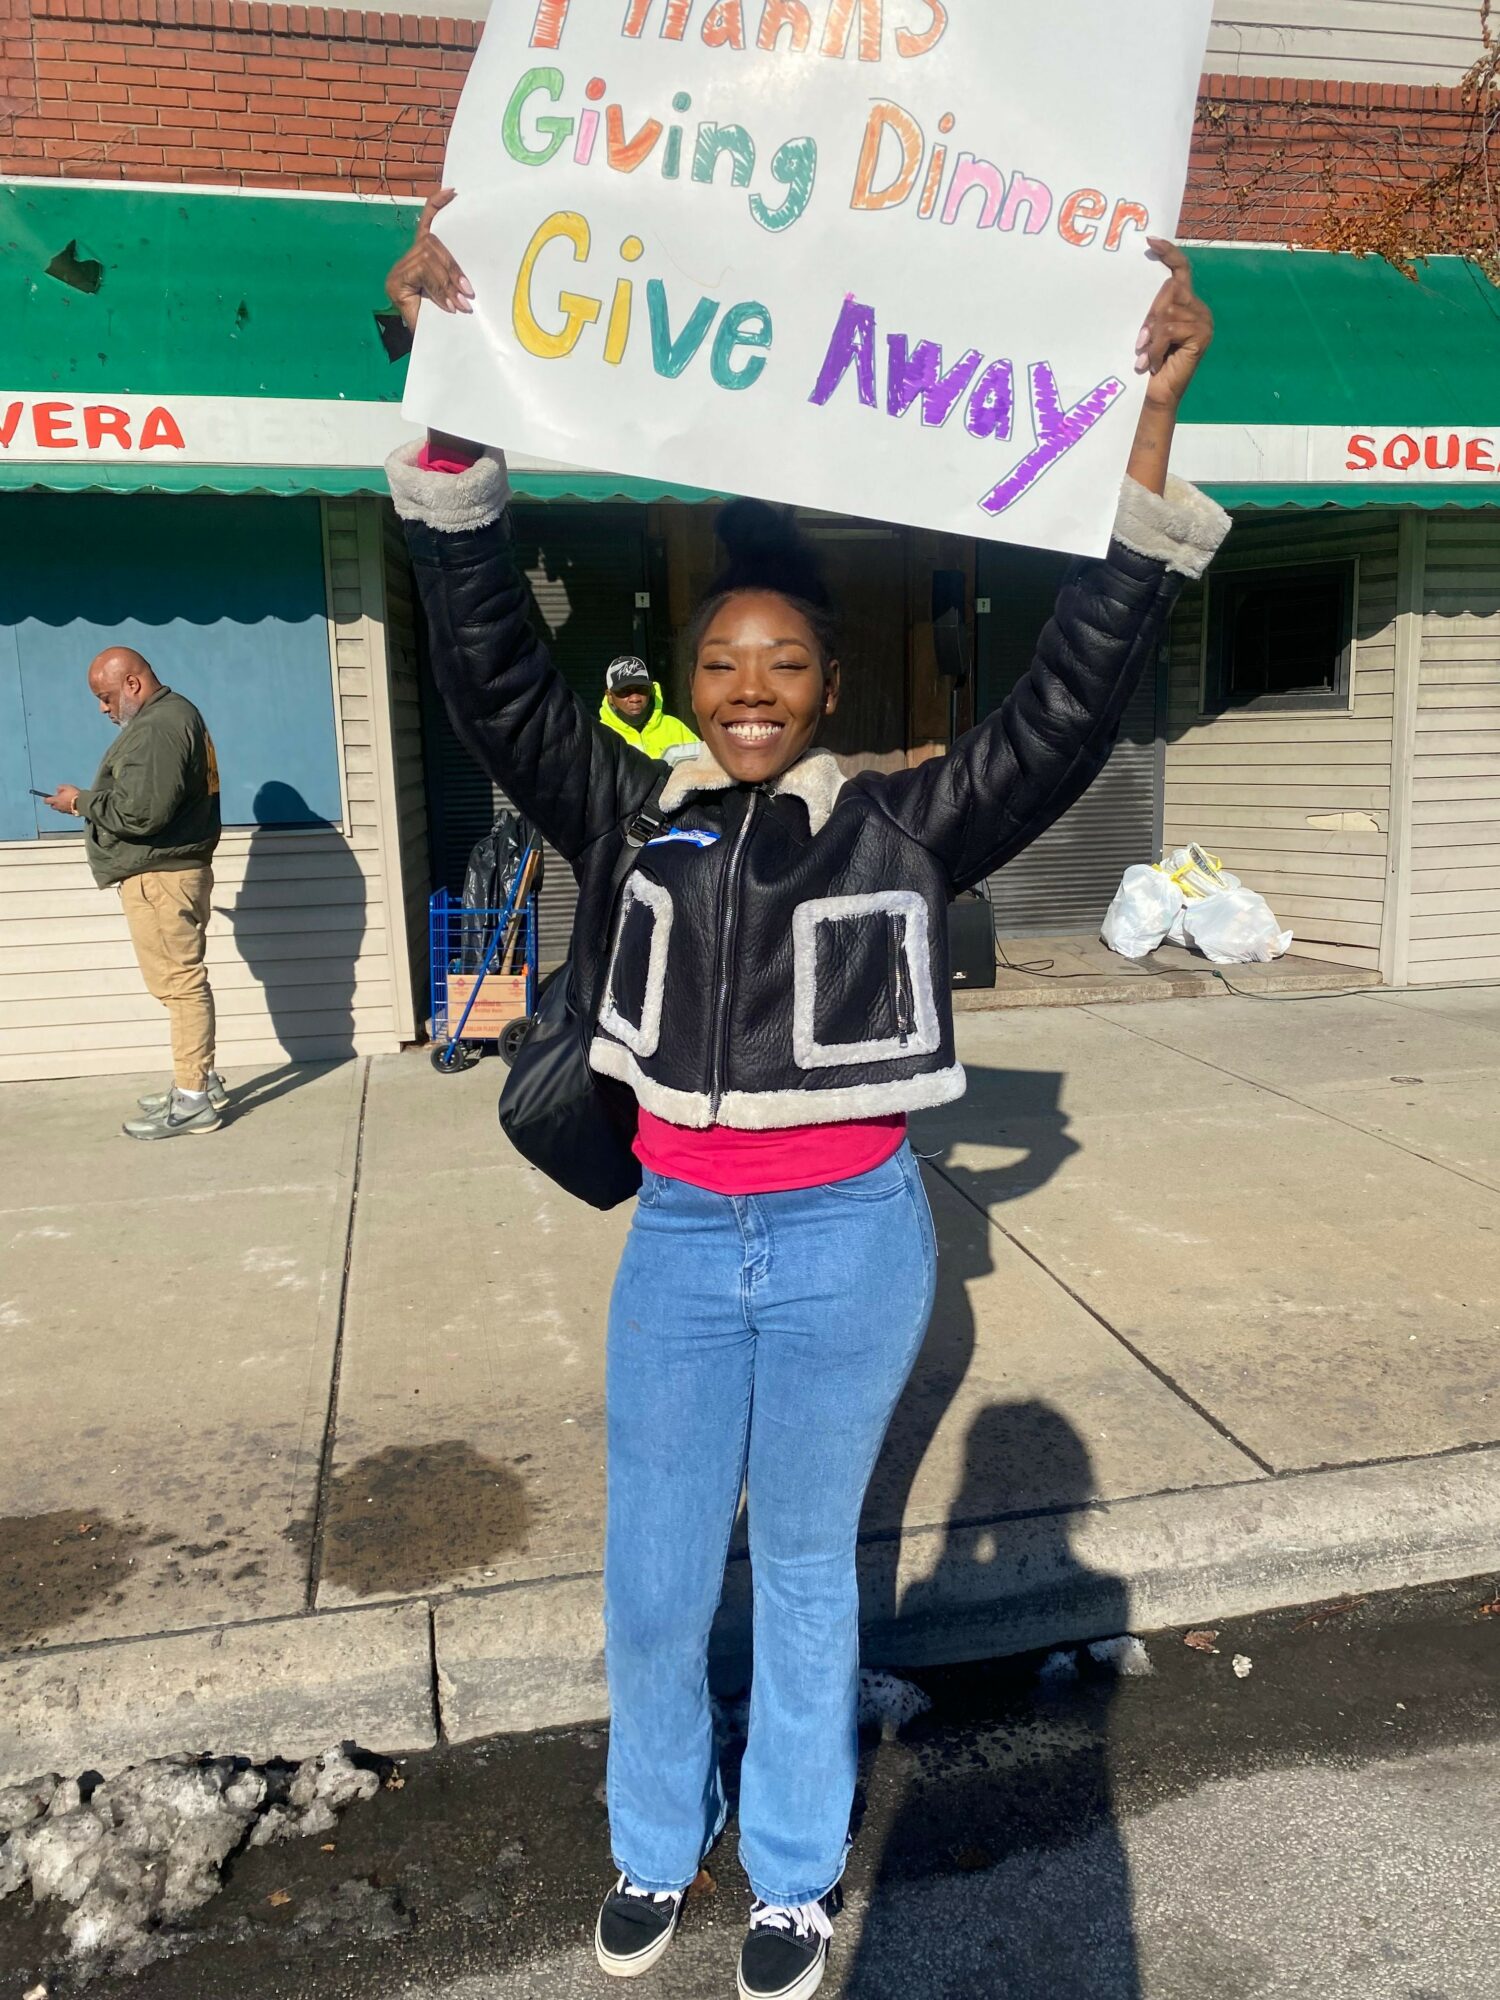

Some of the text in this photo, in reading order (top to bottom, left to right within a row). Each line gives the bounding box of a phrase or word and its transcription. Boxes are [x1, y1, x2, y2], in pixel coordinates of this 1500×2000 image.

[502, 67, 1149, 252] Giving Dinner
[512, 210, 1127, 517] Give Away
[1345, 433, 1500, 473] SQUE
